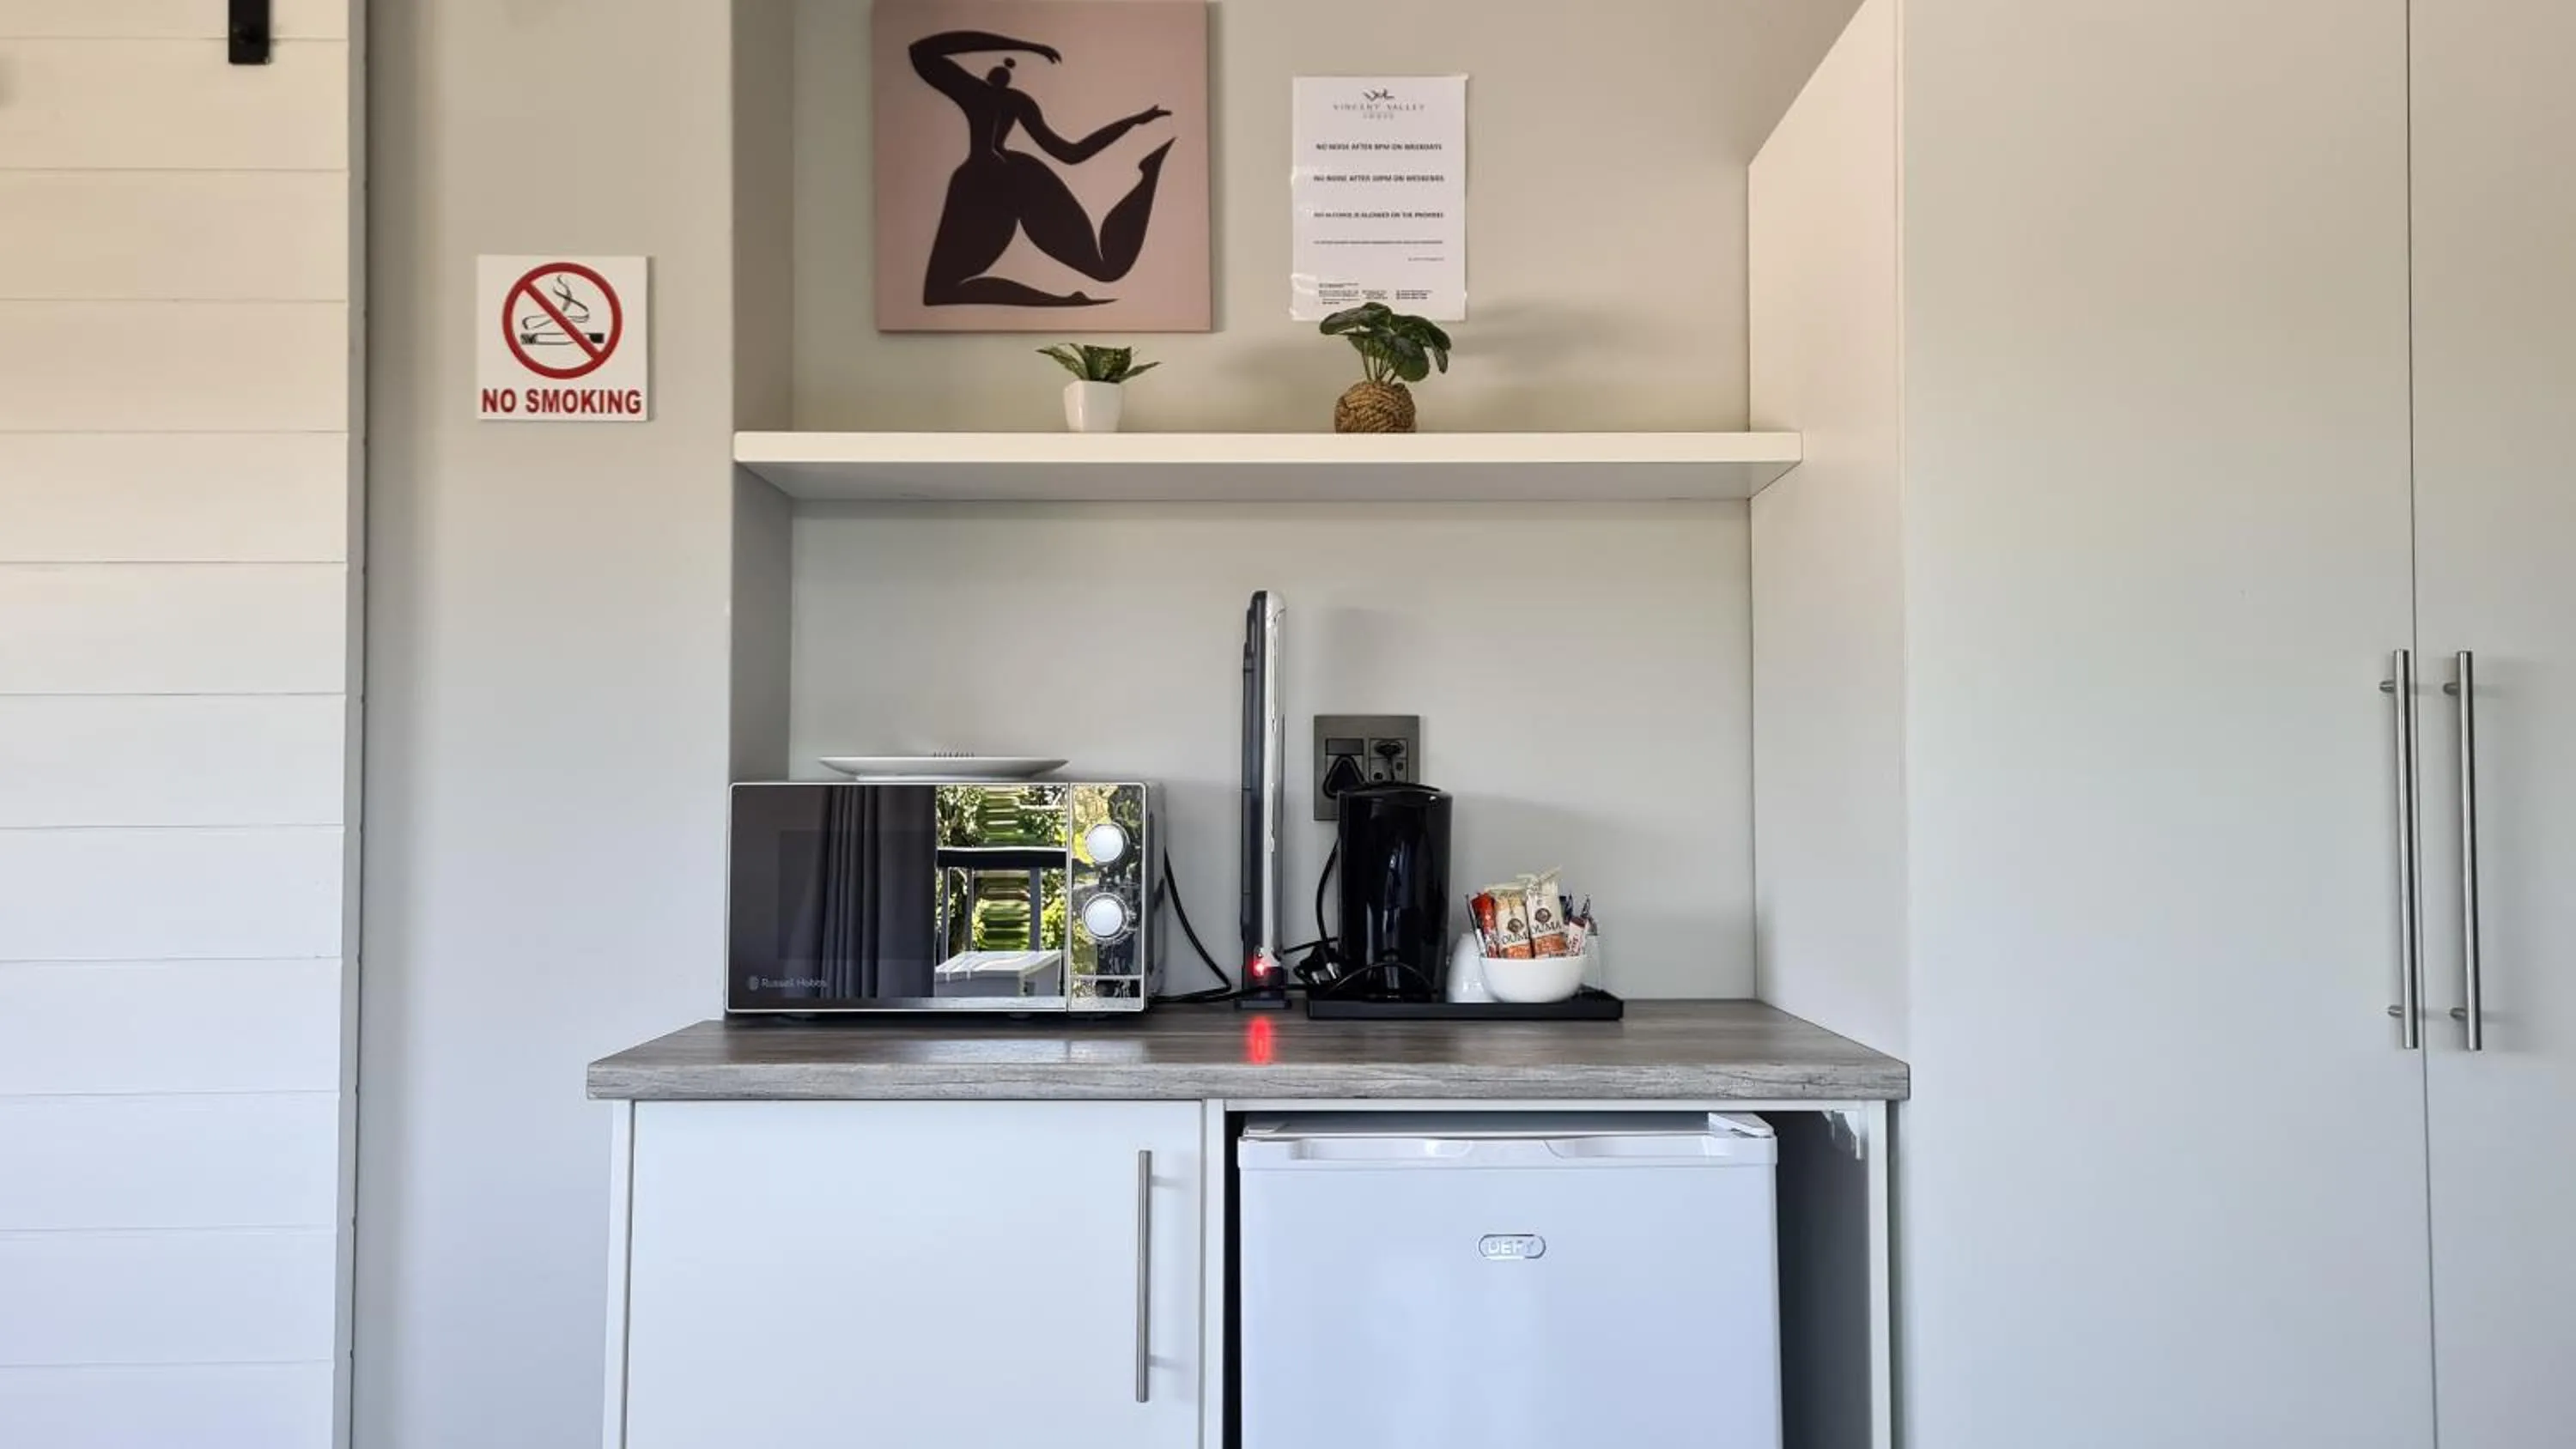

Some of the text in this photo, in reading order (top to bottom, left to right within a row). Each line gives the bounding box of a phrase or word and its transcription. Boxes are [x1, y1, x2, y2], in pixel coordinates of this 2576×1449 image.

[1352, 142, 1372, 151] AFTER
[1392, 142, 1402, 151] ON
[482, 388, 642, 414] NO SMOKING
[1486, 1240, 1535, 1254] DEFY
